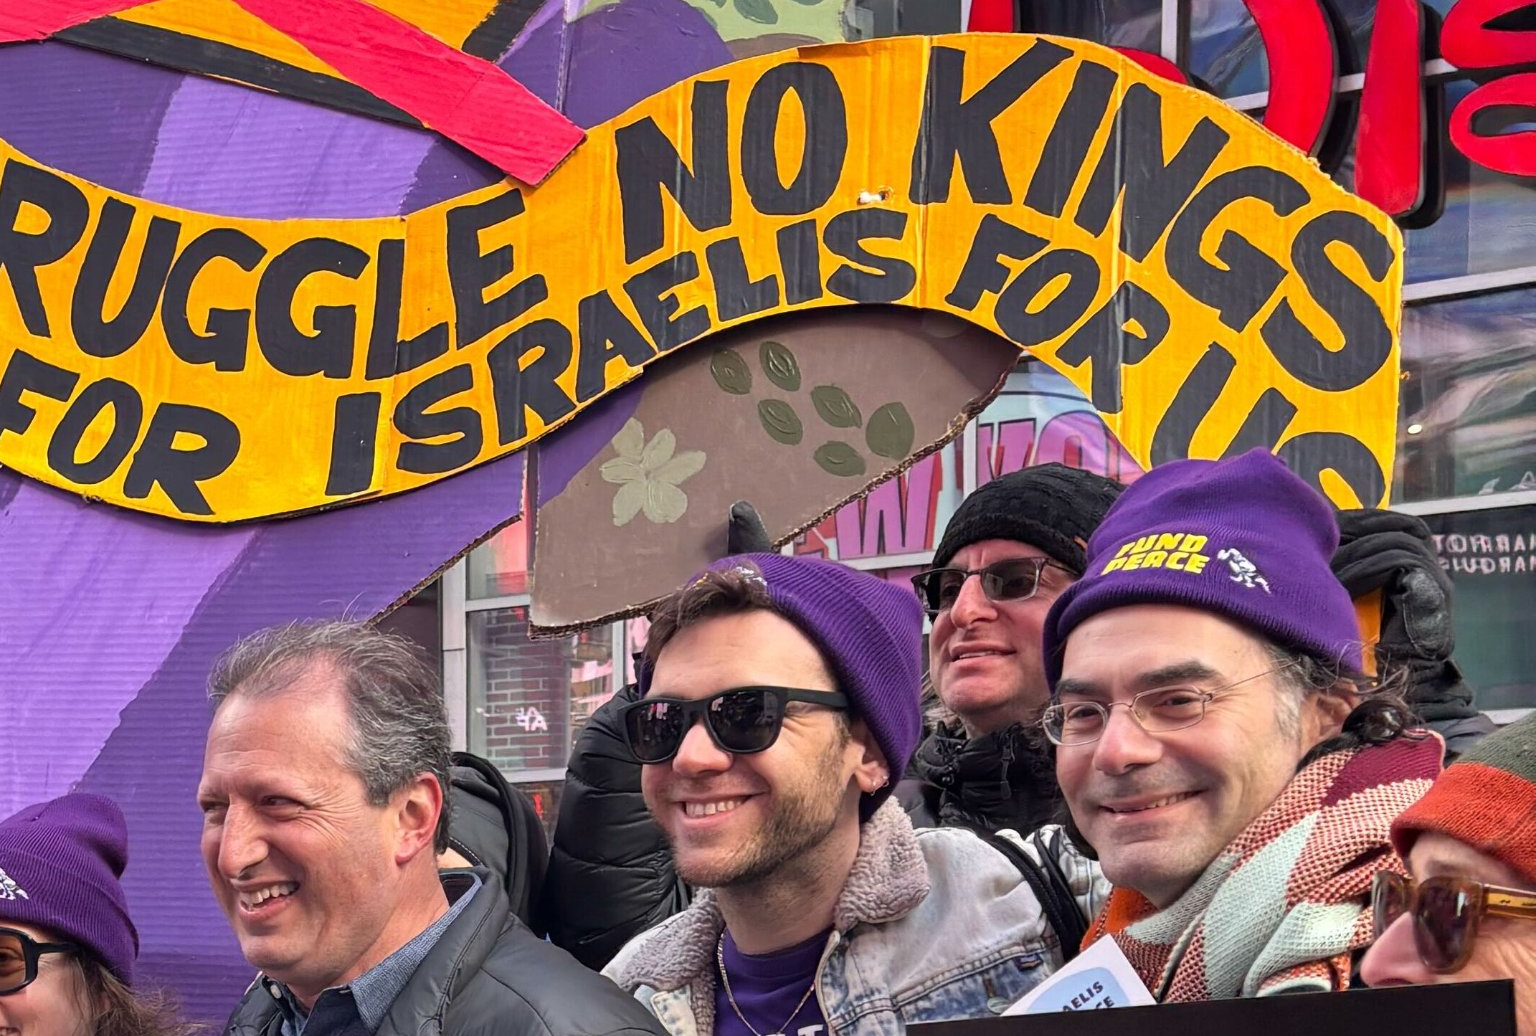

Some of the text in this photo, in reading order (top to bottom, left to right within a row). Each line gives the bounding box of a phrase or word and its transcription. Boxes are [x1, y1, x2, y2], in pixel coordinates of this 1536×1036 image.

[614, 62, 848, 265] NO
[908, 37, 1396, 392] KINGS
[325, 208, 916, 496] ISRAELIS
[944, 213, 1170, 413] FOR
[1100, 549, 1211, 577] PEACE
[1115, 532, 1209, 559] FUND
